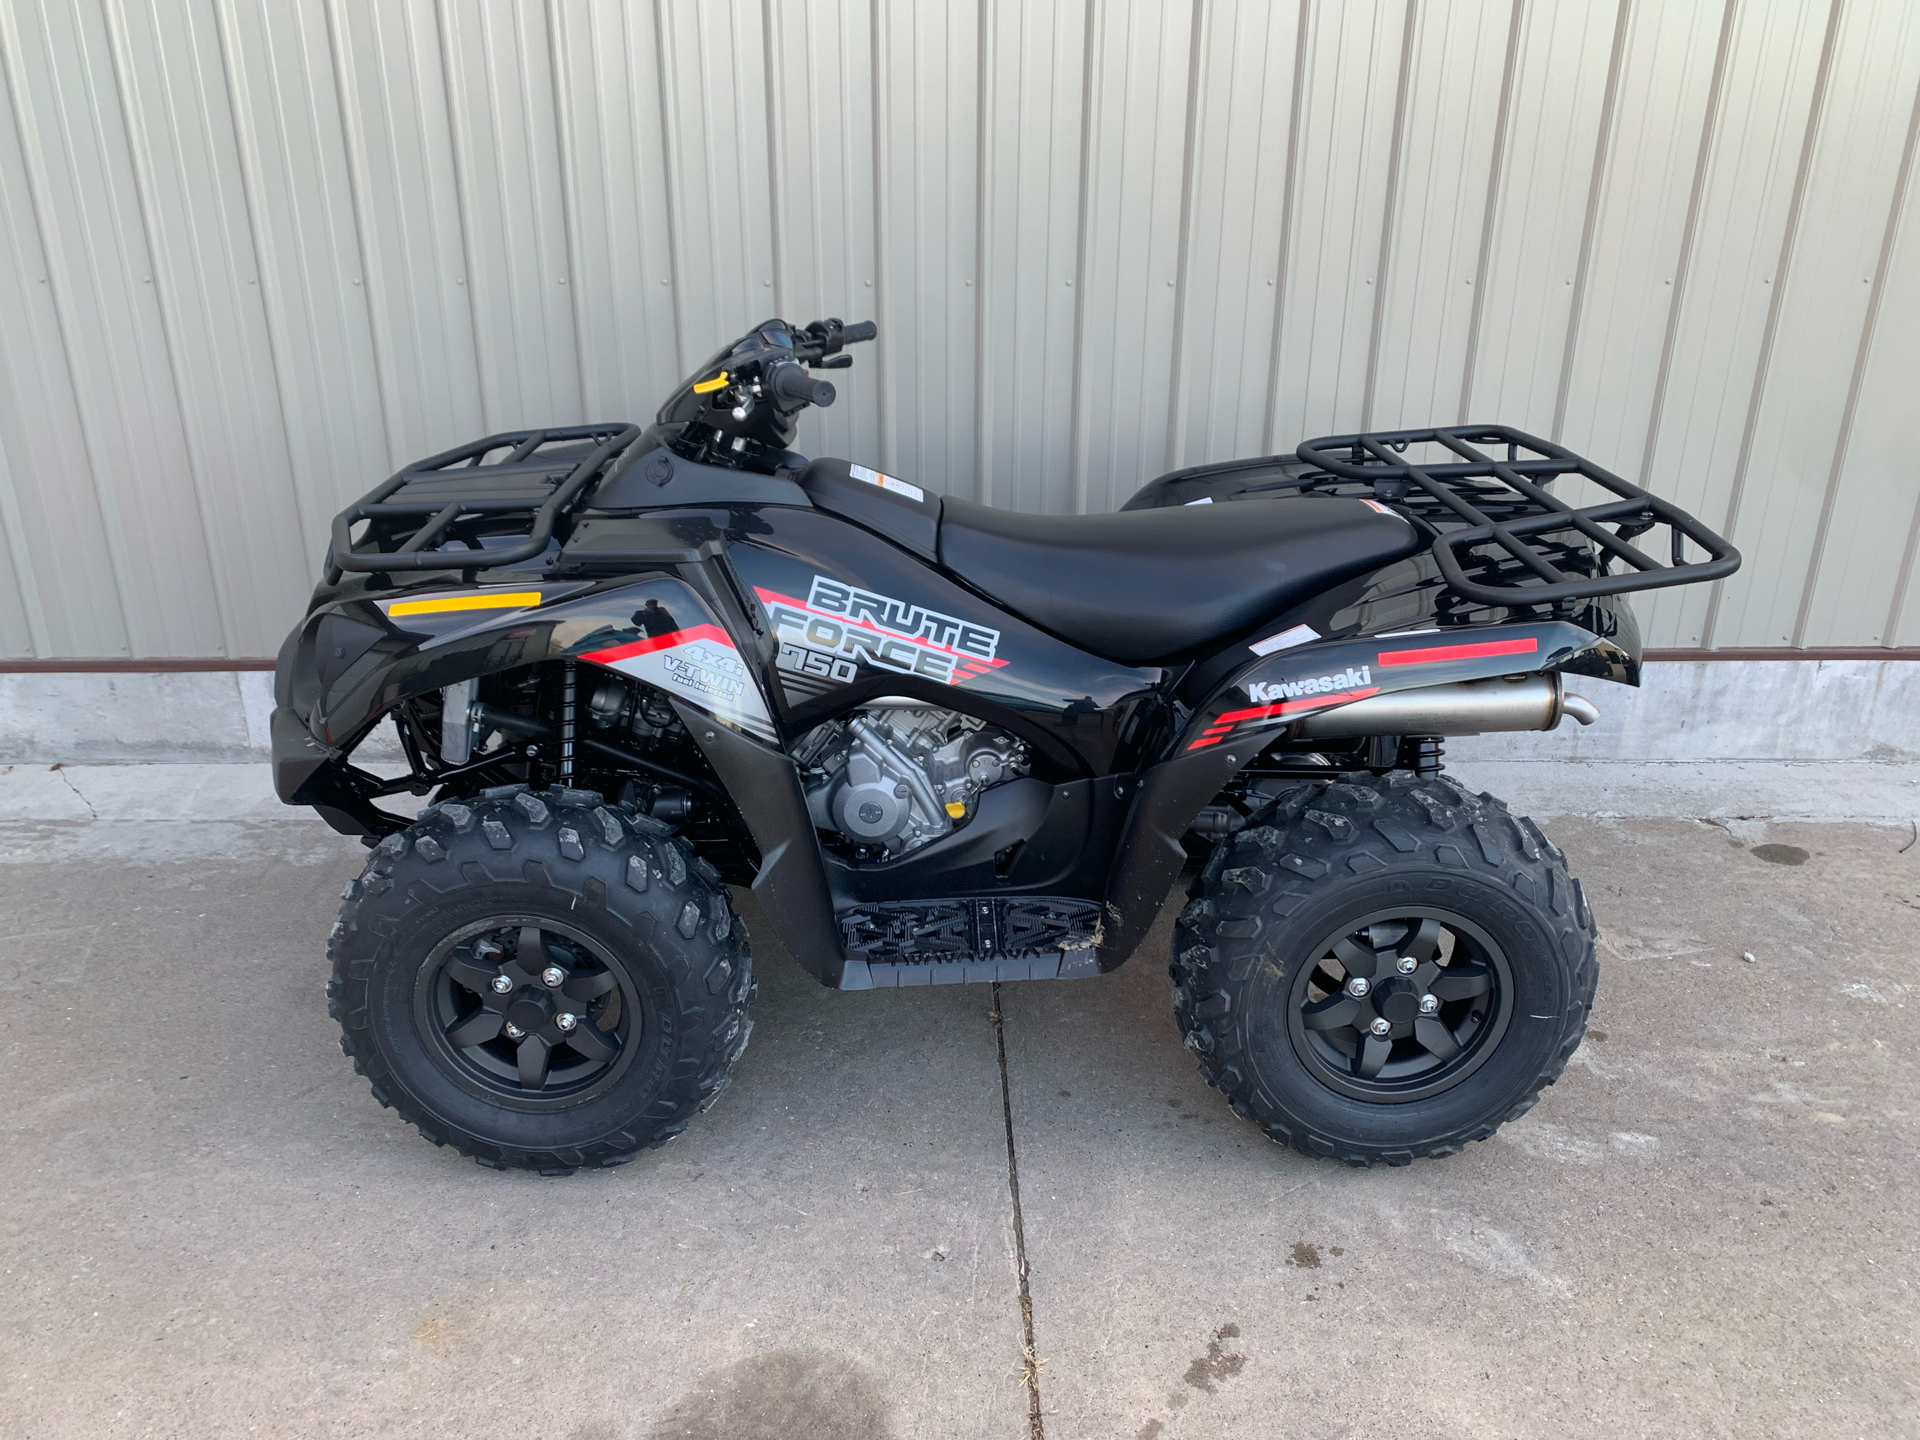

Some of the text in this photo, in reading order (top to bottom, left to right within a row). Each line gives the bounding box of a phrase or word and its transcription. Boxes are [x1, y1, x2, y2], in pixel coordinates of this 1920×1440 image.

[769, 601, 958, 685] FORCE
[806, 574, 1000, 662] BRUTE
[664, 654, 745, 696] V-TWIN
[682, 645, 745, 677] 4x4i
[780, 642, 858, 684] 750
[1248, 665, 1371, 703] Kawasaki
[1423, 876, 1538, 941] DURO
[639, 1012, 673, 1099] DURO
